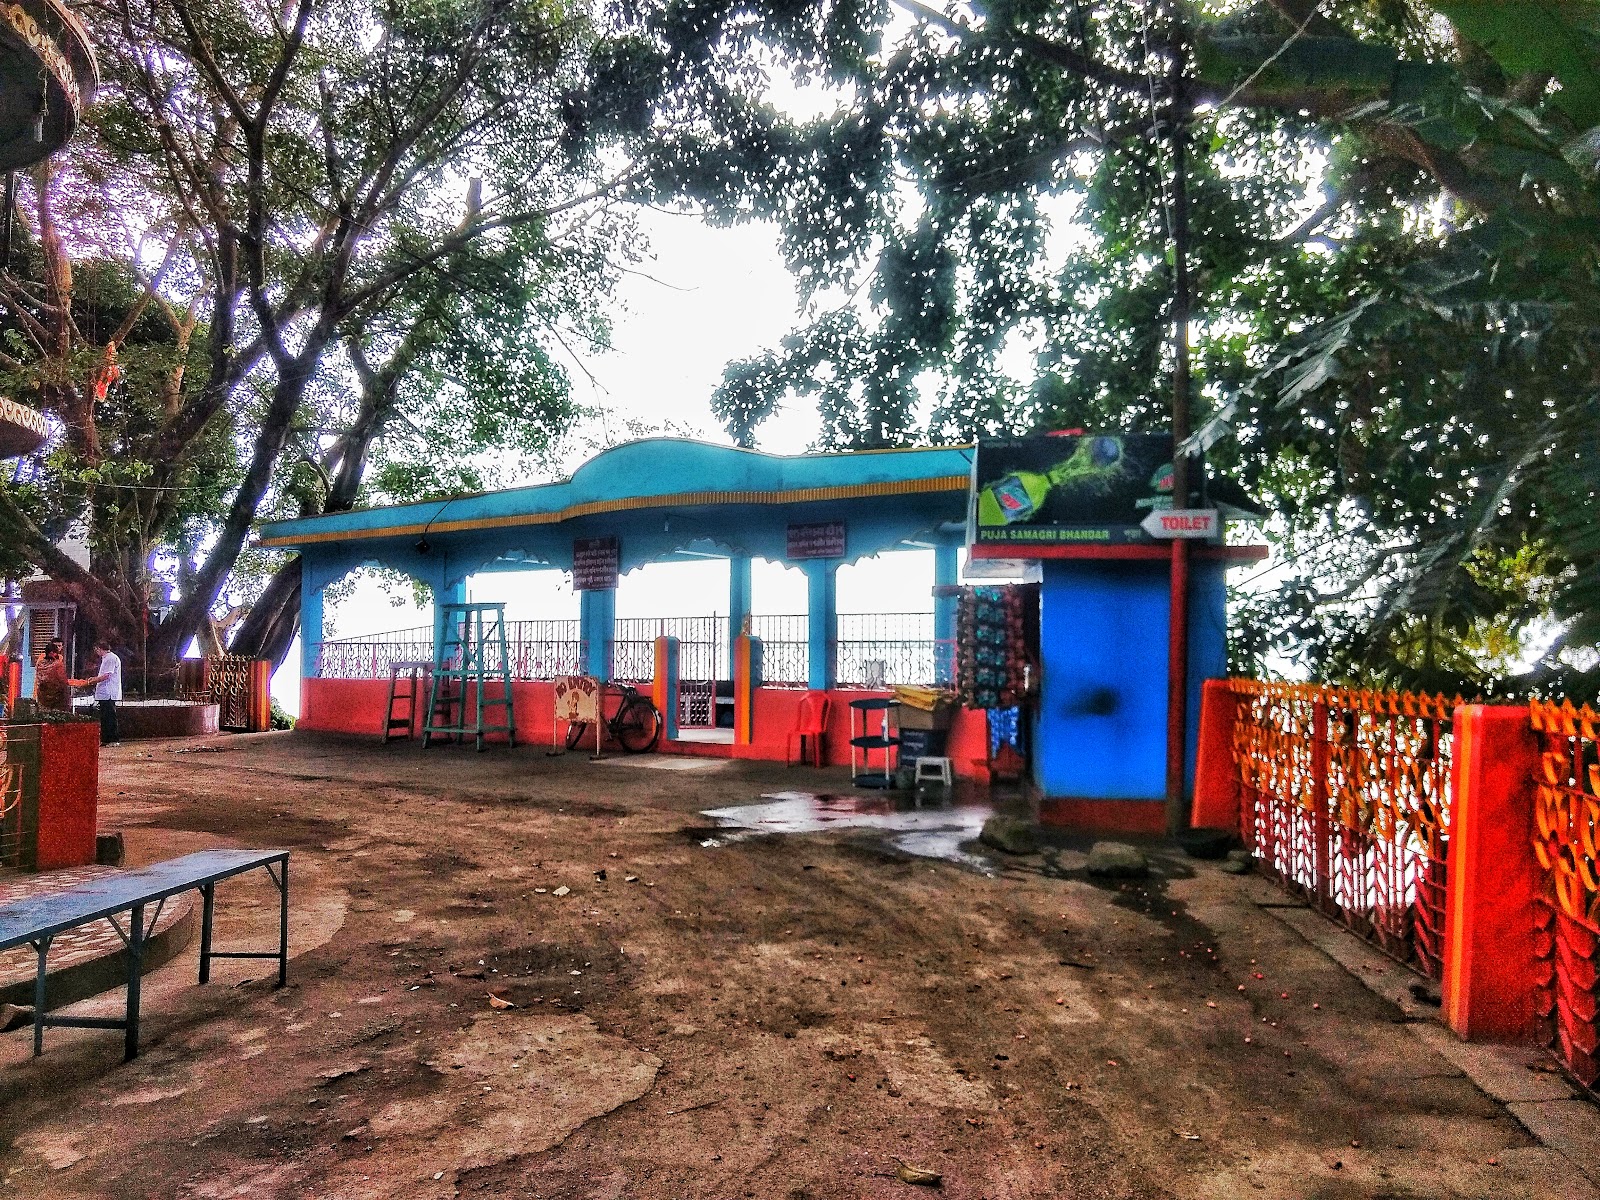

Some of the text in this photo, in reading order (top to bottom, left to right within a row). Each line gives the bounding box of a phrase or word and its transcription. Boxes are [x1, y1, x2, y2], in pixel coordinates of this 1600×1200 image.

[1160, 515, 1211, 530] TOILET
[980, 529, 1110, 540] PUJA SAMAGRI BHANDAR
